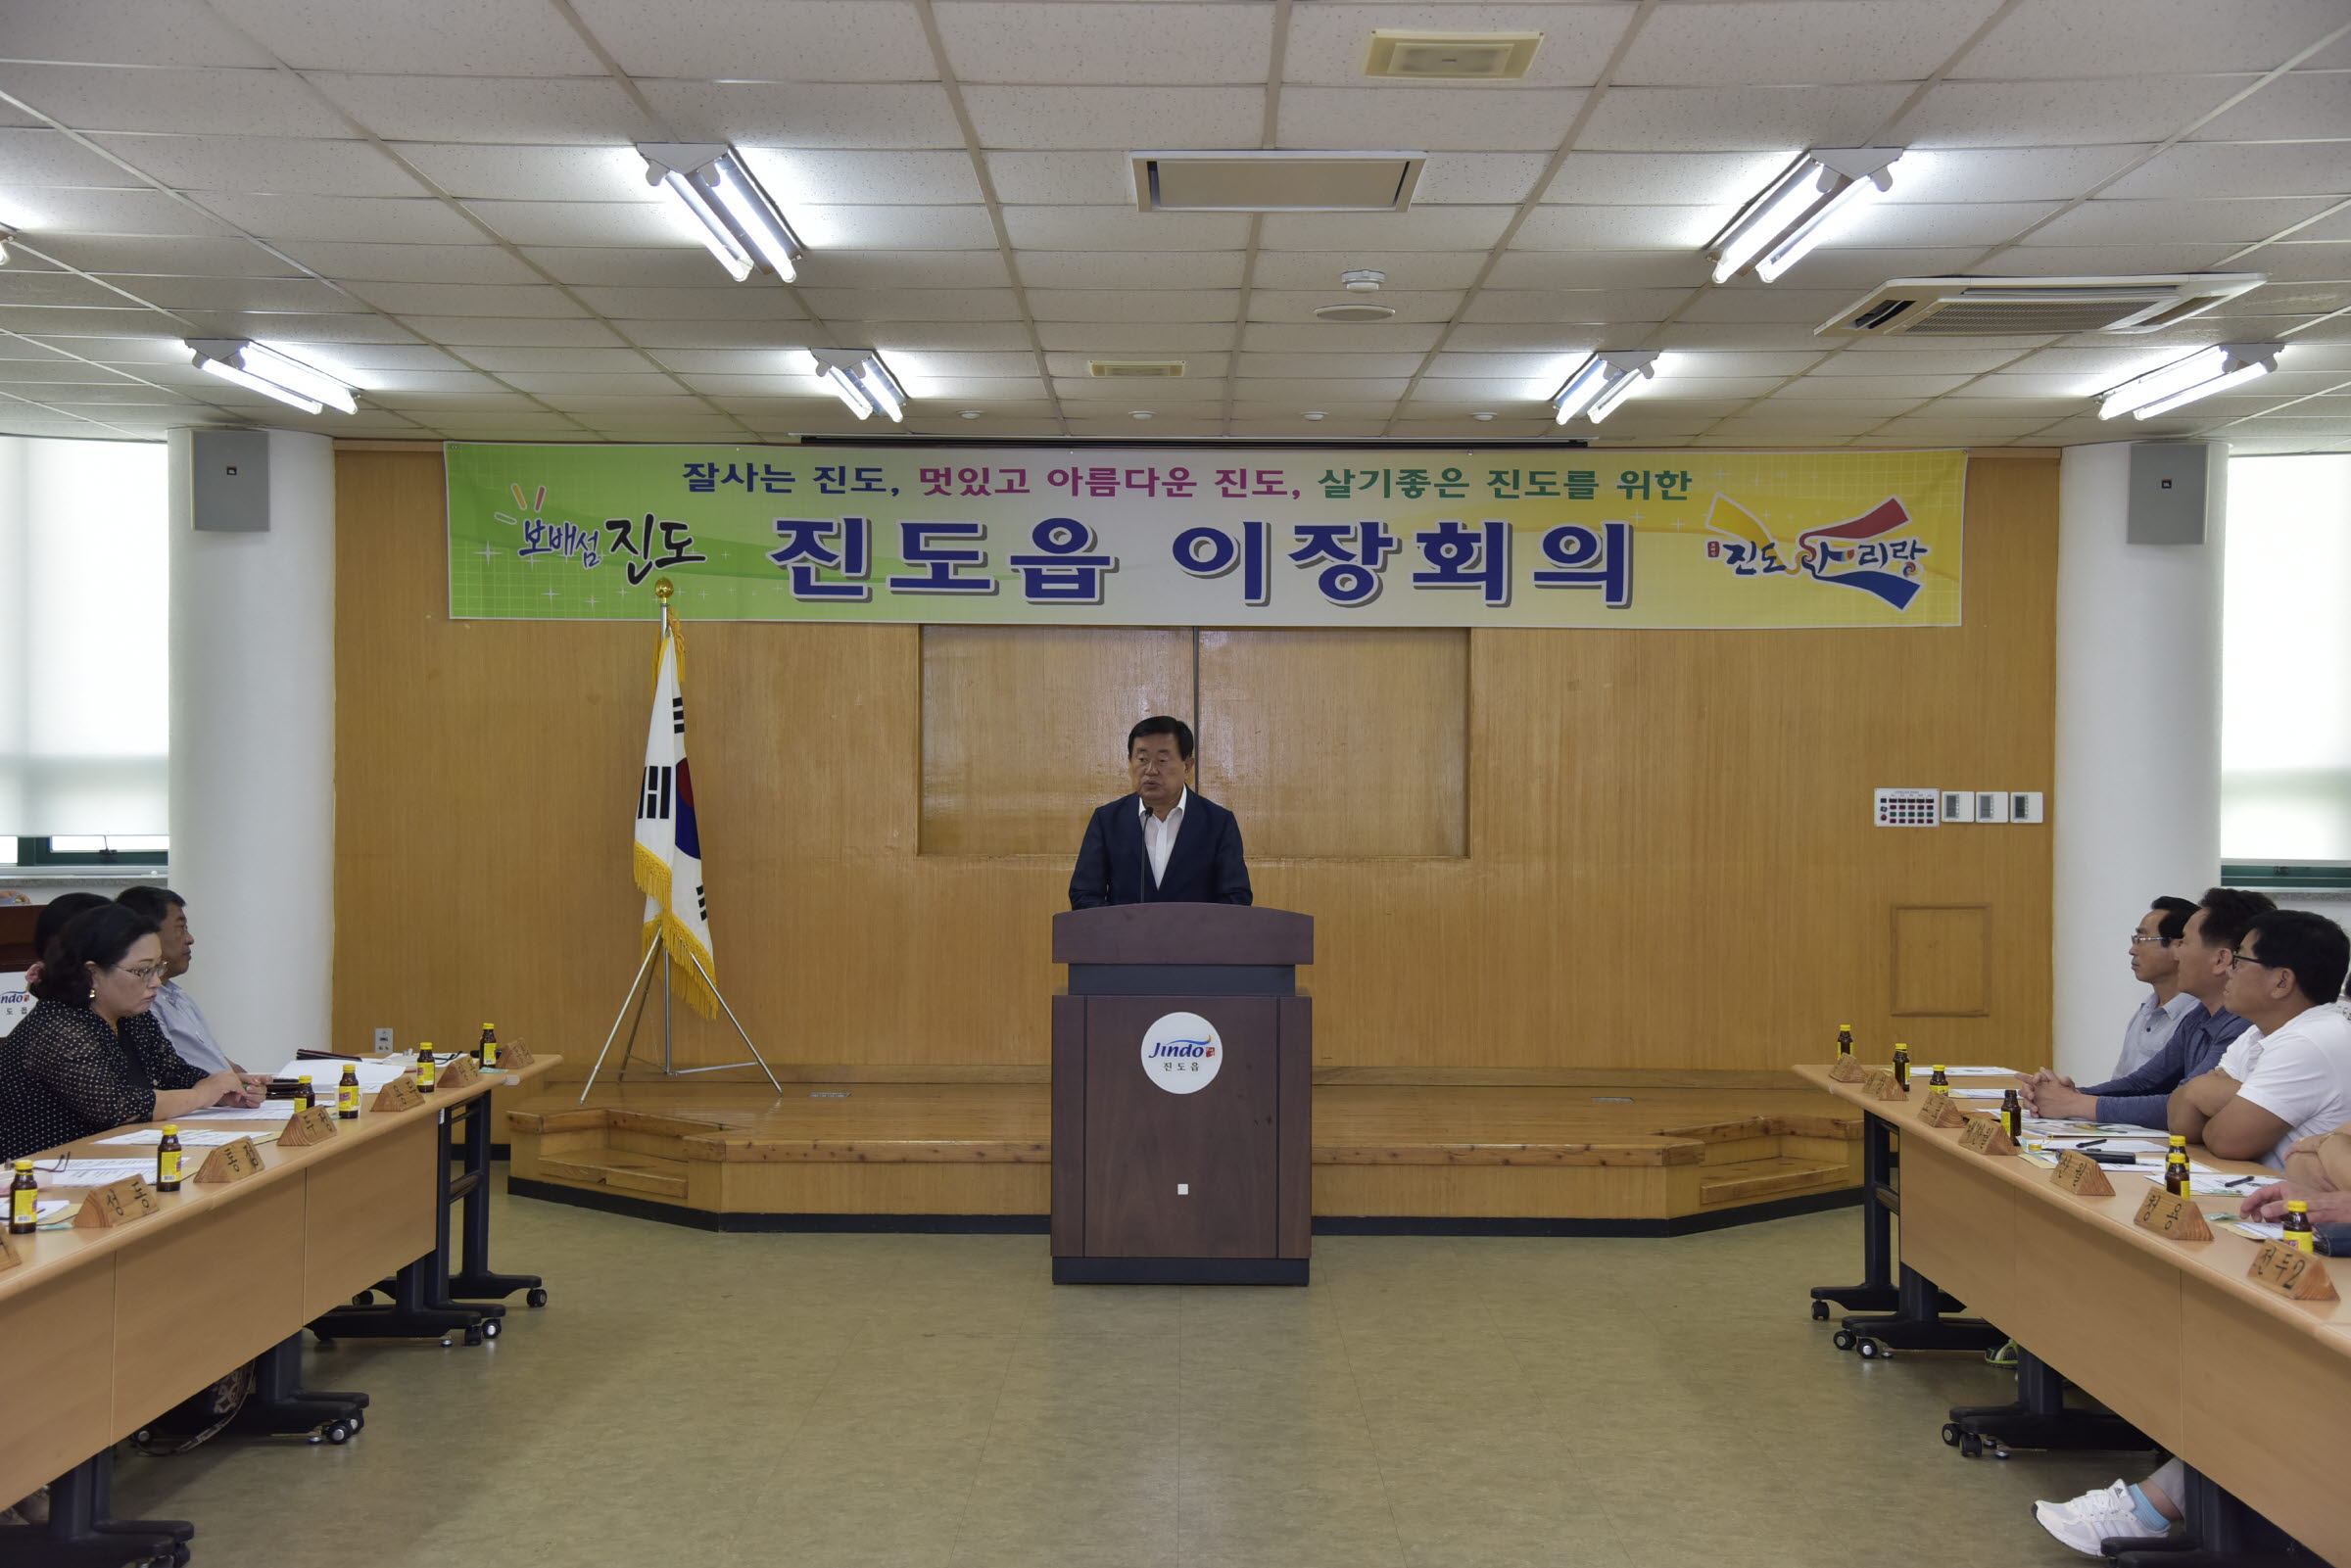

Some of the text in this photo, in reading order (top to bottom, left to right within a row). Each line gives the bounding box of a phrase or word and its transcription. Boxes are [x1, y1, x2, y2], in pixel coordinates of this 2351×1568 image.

[684, 462, 1693, 500] 잘사는 진도, 멋있고 아름다운 진도, 살기좋은 진도를 위한
[518, 512, 707, 586] 보배섬 진도
[769, 516, 1632, 608] 진도읍 이장회의
[1148, 1041, 1205, 1059] Jindo
